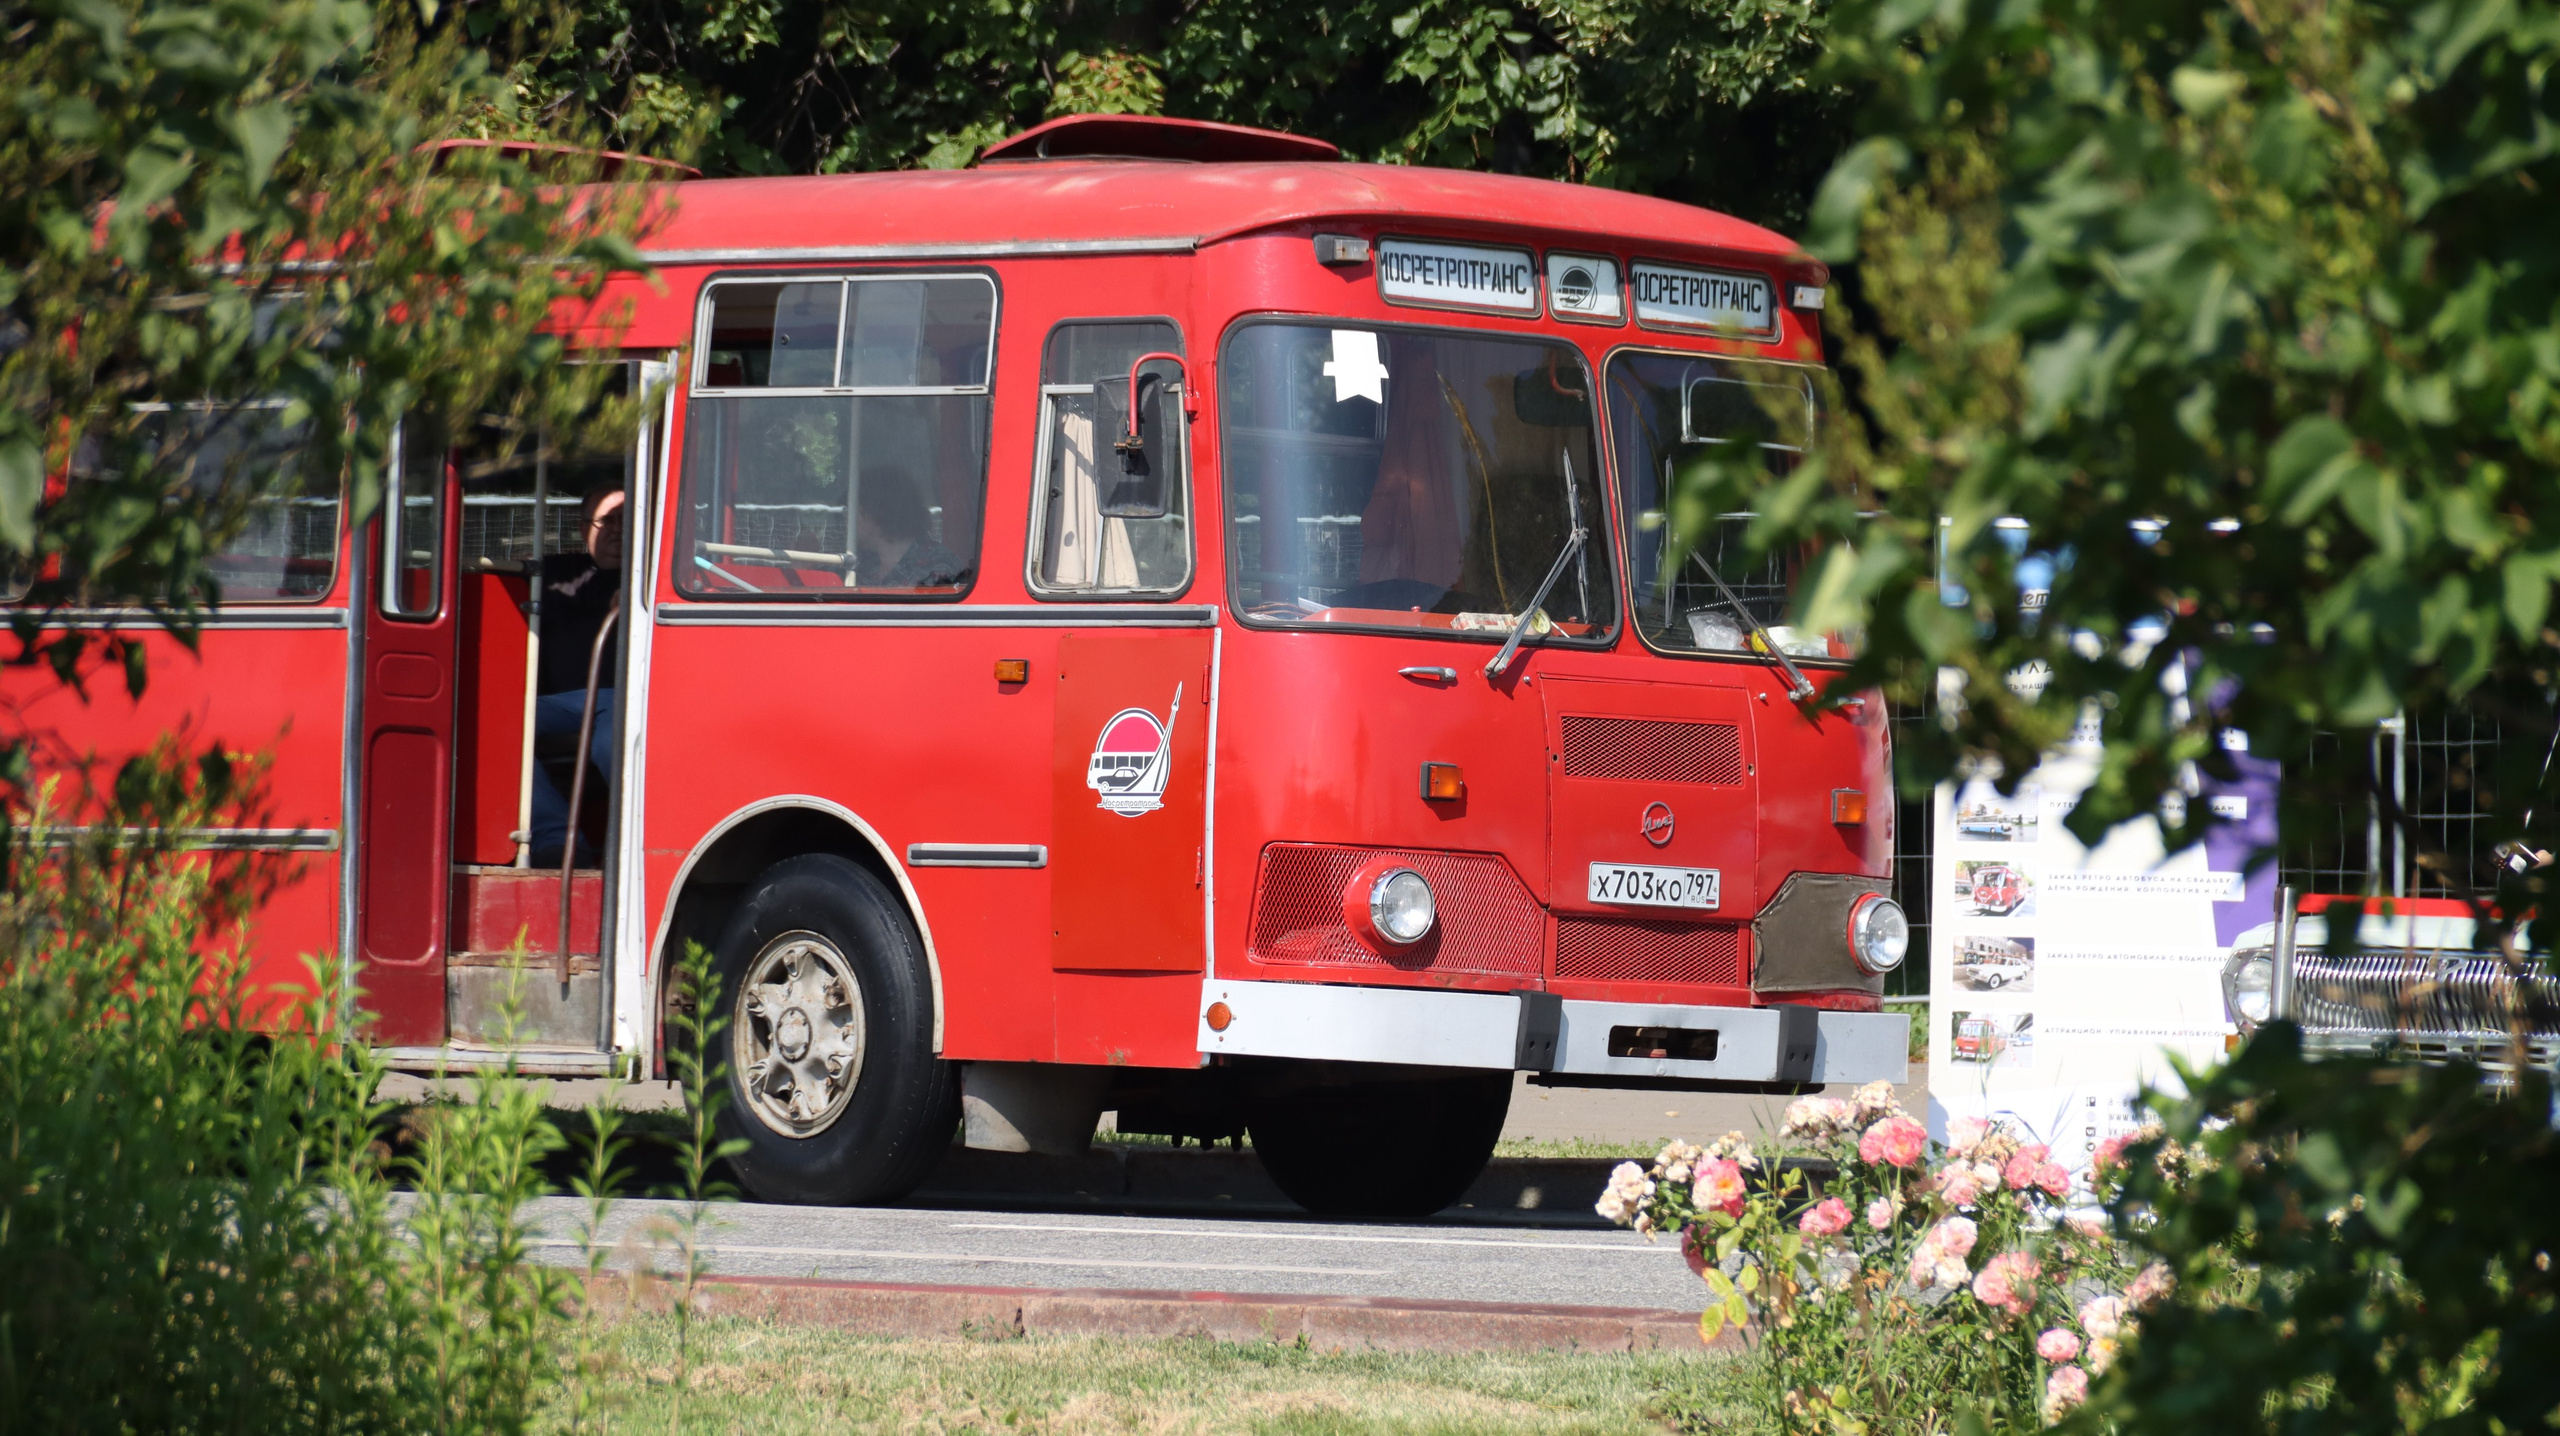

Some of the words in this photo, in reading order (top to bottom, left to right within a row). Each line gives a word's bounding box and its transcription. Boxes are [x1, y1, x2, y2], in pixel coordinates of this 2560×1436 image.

[2048, 873, 2078, 881] ЗАКАЗ
[2081, 874, 2112, 882] РЕТРО
[2115, 875, 2165, 883] АВТОБУСА
[1686, 873, 1714, 896] 797
[2136, 886, 2200, 894] КОРПОРАТИВ
[1691, 895, 1705, 904] RUS
[2045, 1027, 2102, 1035] АТТРАКЦИОН
